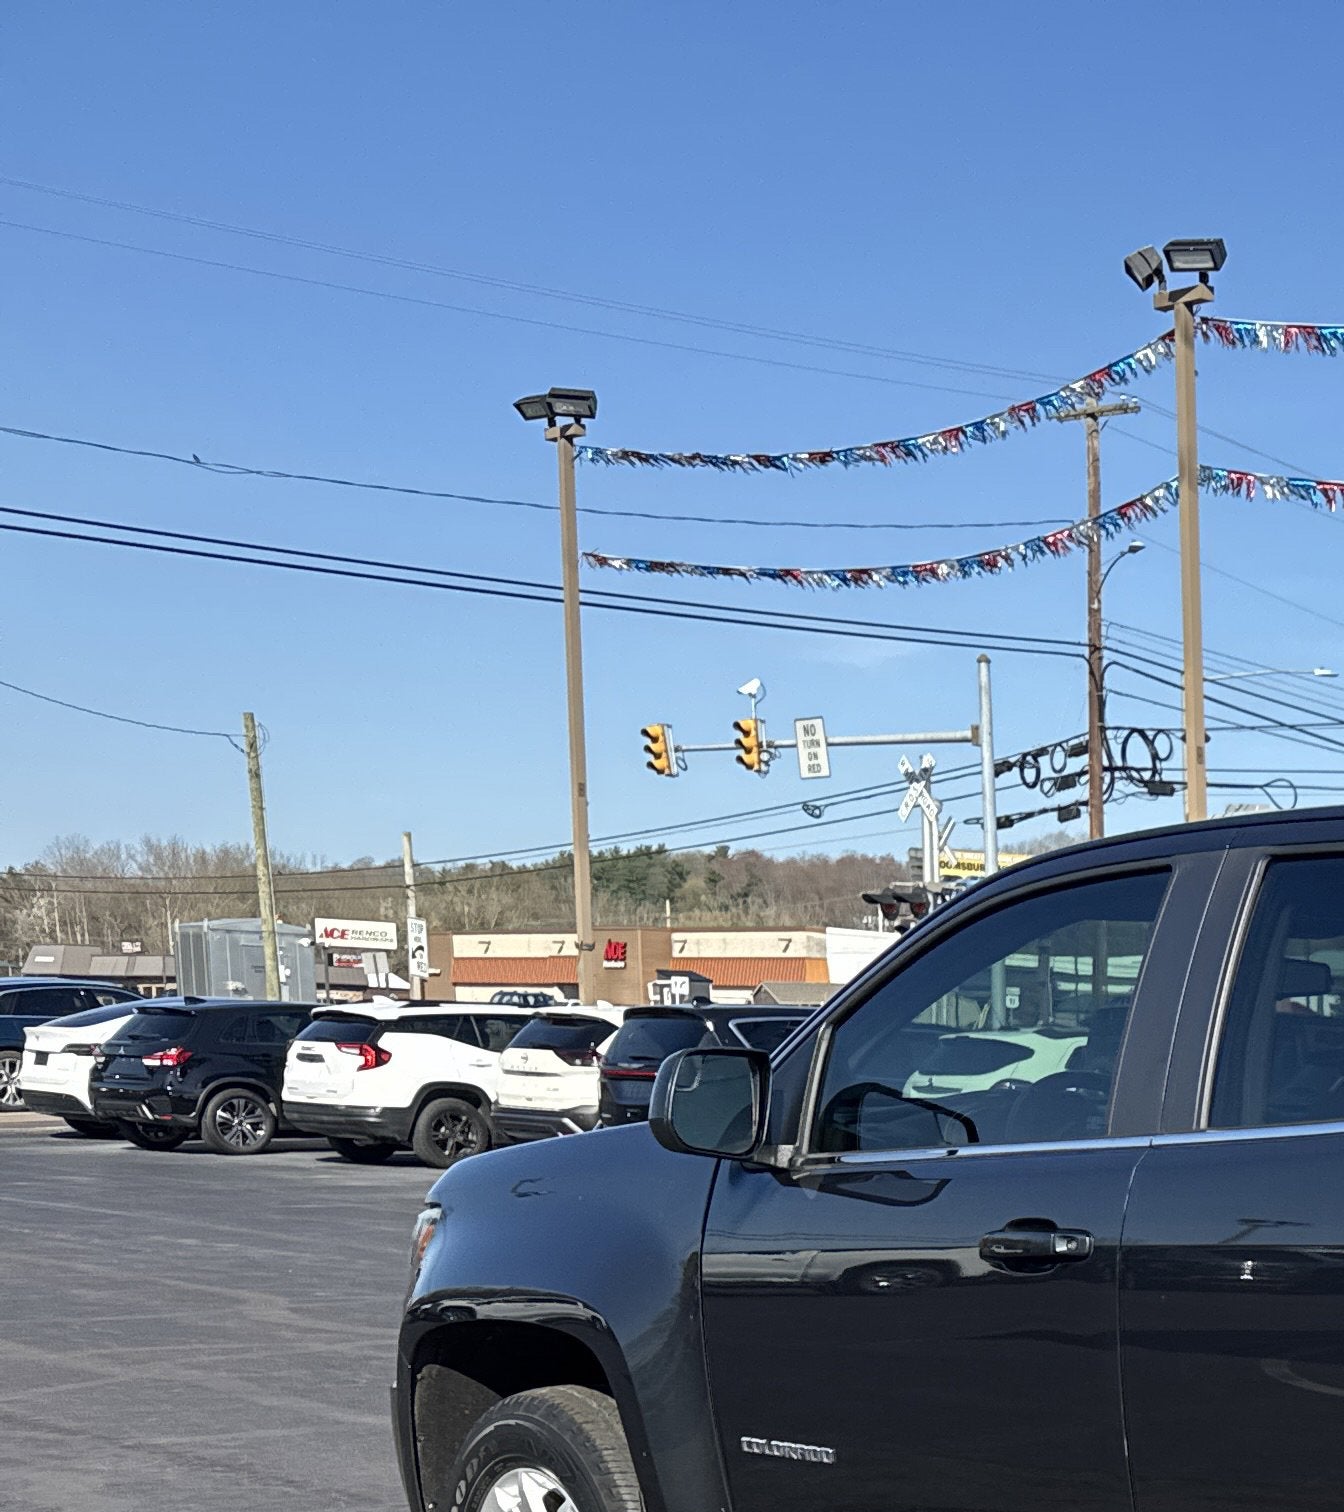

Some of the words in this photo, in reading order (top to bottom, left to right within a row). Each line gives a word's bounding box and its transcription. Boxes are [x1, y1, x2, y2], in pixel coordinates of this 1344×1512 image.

[802, 723, 817, 738] NO
[801, 738, 821, 750] TURN
[807, 751, 819, 762] ON
[807, 762, 822, 774] RED
[318, 926, 350, 941] ACE
[740, 1435, 838, 1466] COLORADO
